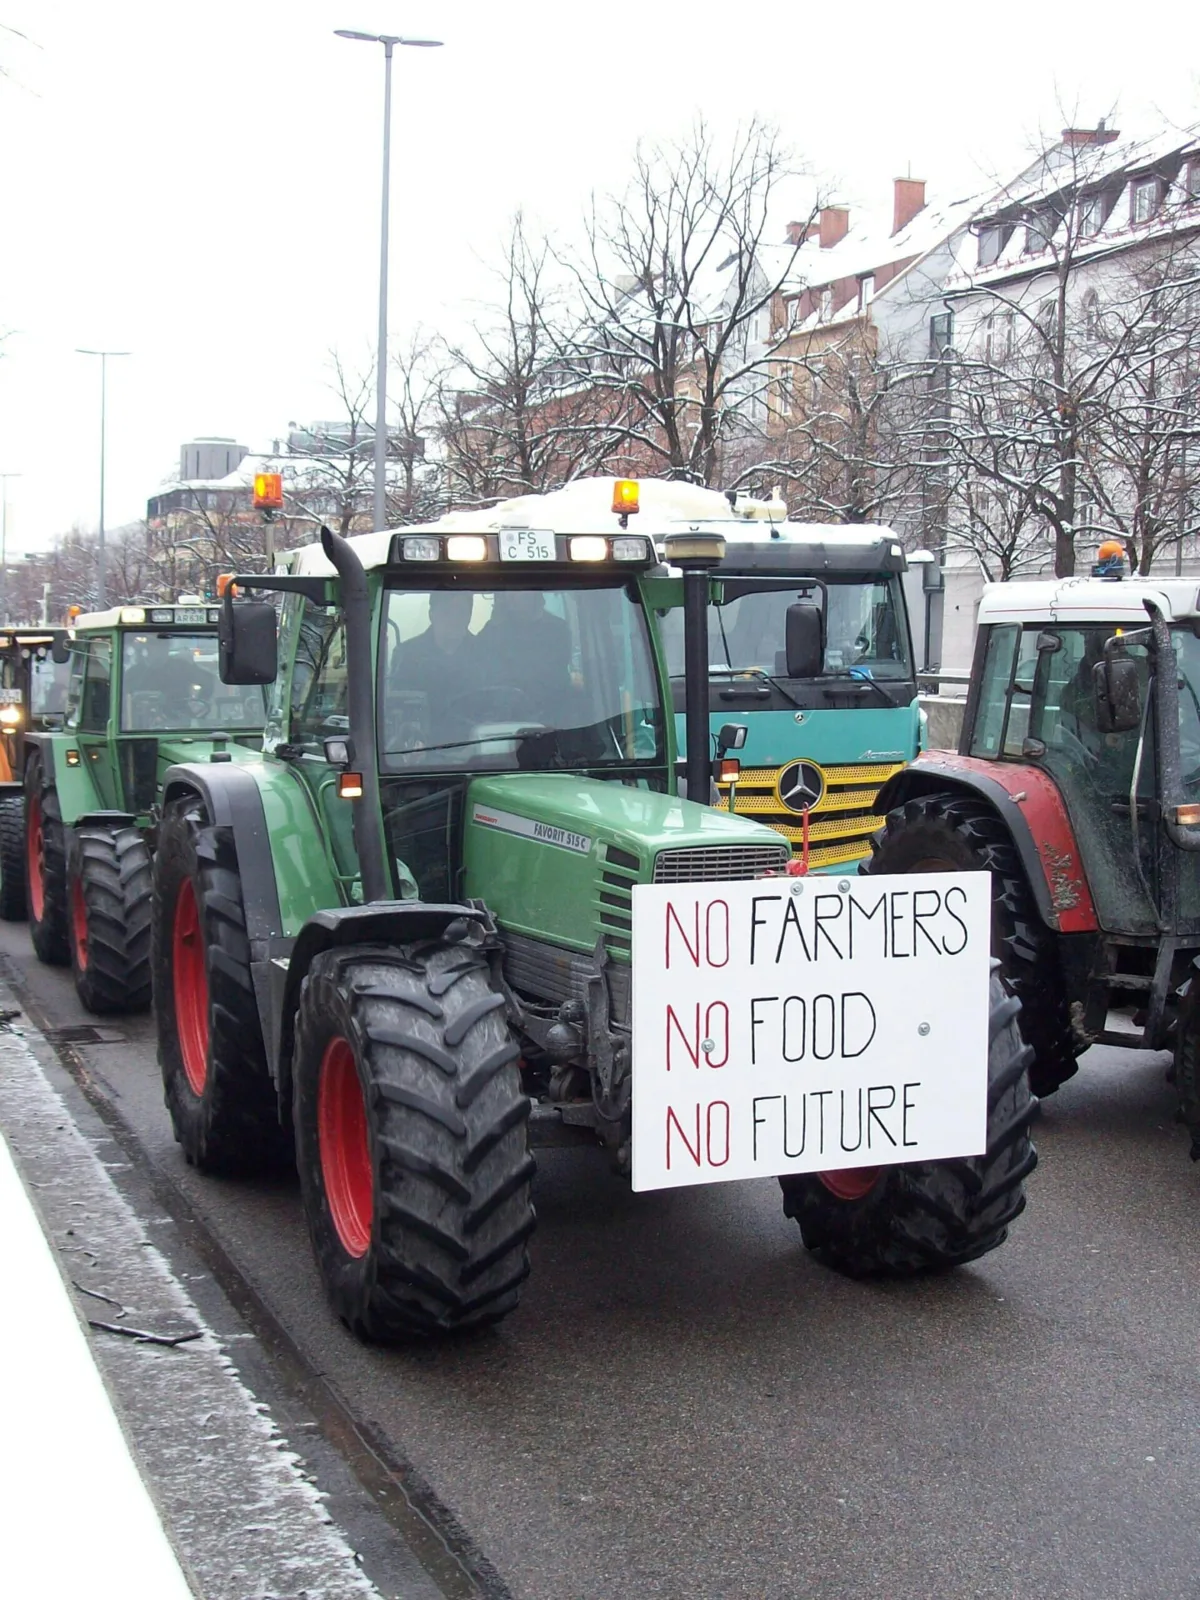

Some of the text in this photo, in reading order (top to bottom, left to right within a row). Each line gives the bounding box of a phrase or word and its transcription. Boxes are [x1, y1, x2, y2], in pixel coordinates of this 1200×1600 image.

[508, 546, 549, 559] C 515
[518, 532, 537, 545] FS
[534, 823, 565, 843] FAVORIT
[665, 886, 968, 969] NO FARMERS
[666, 992, 877, 1071] NO FOOD
[666, 1082, 921, 1170] NO FUTURE
